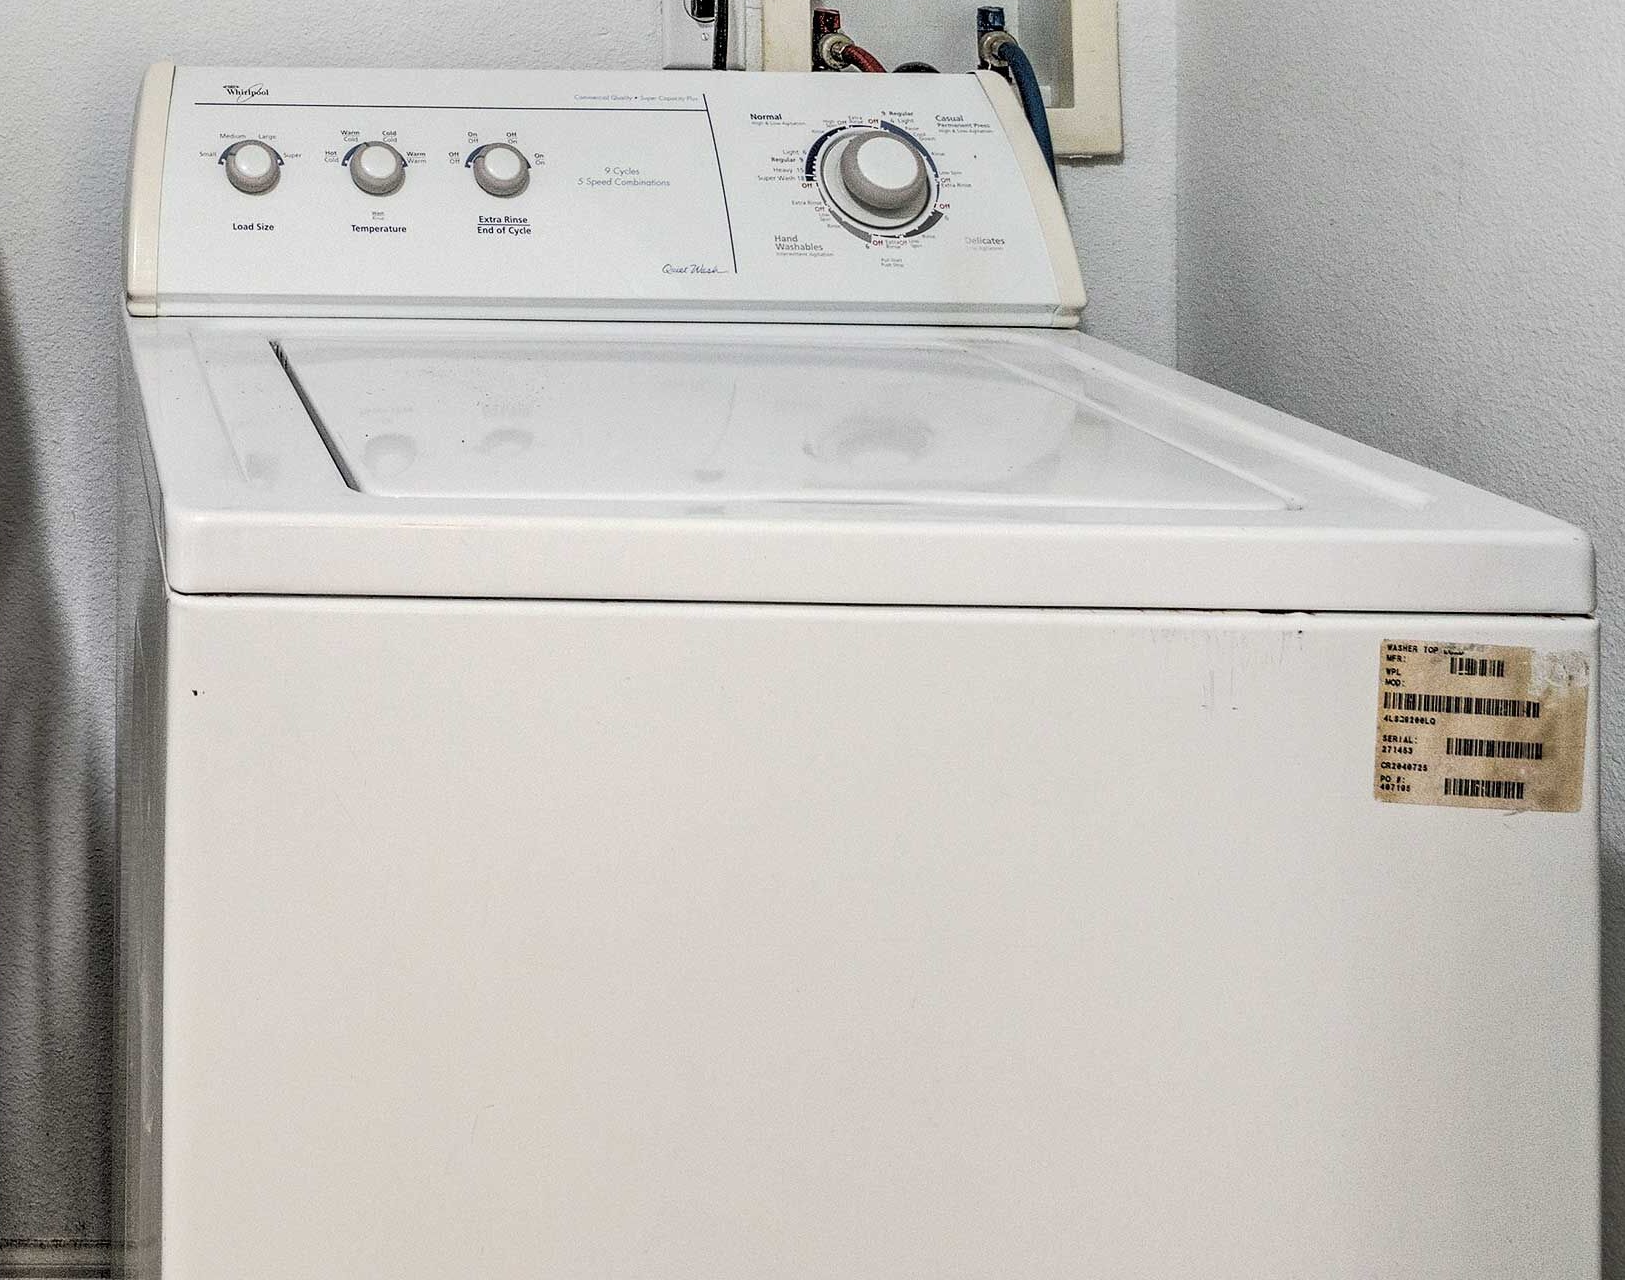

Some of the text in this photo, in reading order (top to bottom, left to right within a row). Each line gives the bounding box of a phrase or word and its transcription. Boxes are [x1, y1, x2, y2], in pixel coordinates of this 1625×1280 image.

[226, 86, 269, 98] Whirlpool
[750, 113, 783, 121] Normal
[935, 114, 964, 122] Casual
[604, 166, 640, 176] 9 Cycles
[586, 177, 613, 187] Speed
[614, 177, 671, 187] Combinations
[478, 215, 528, 224] Extra Rinse
[232, 222, 274, 231] Load Size
[351, 224, 407, 234] Temperature
[477, 226, 532, 236] End of Cycle
[774, 234, 798, 242] Hand
[776, 243, 824, 251] Washables
[1387, 644, 1418, 653] WASHER
[1424, 646, 1439, 654] TOP
[1386, 654, 1406, 663] MFR:
[1385, 668, 1402, 676] WPL
[1384, 678, 1405, 687] MOD:
[1382, 734, 1418, 744] SERIAL:
[1379, 774, 1392, 783] PO
